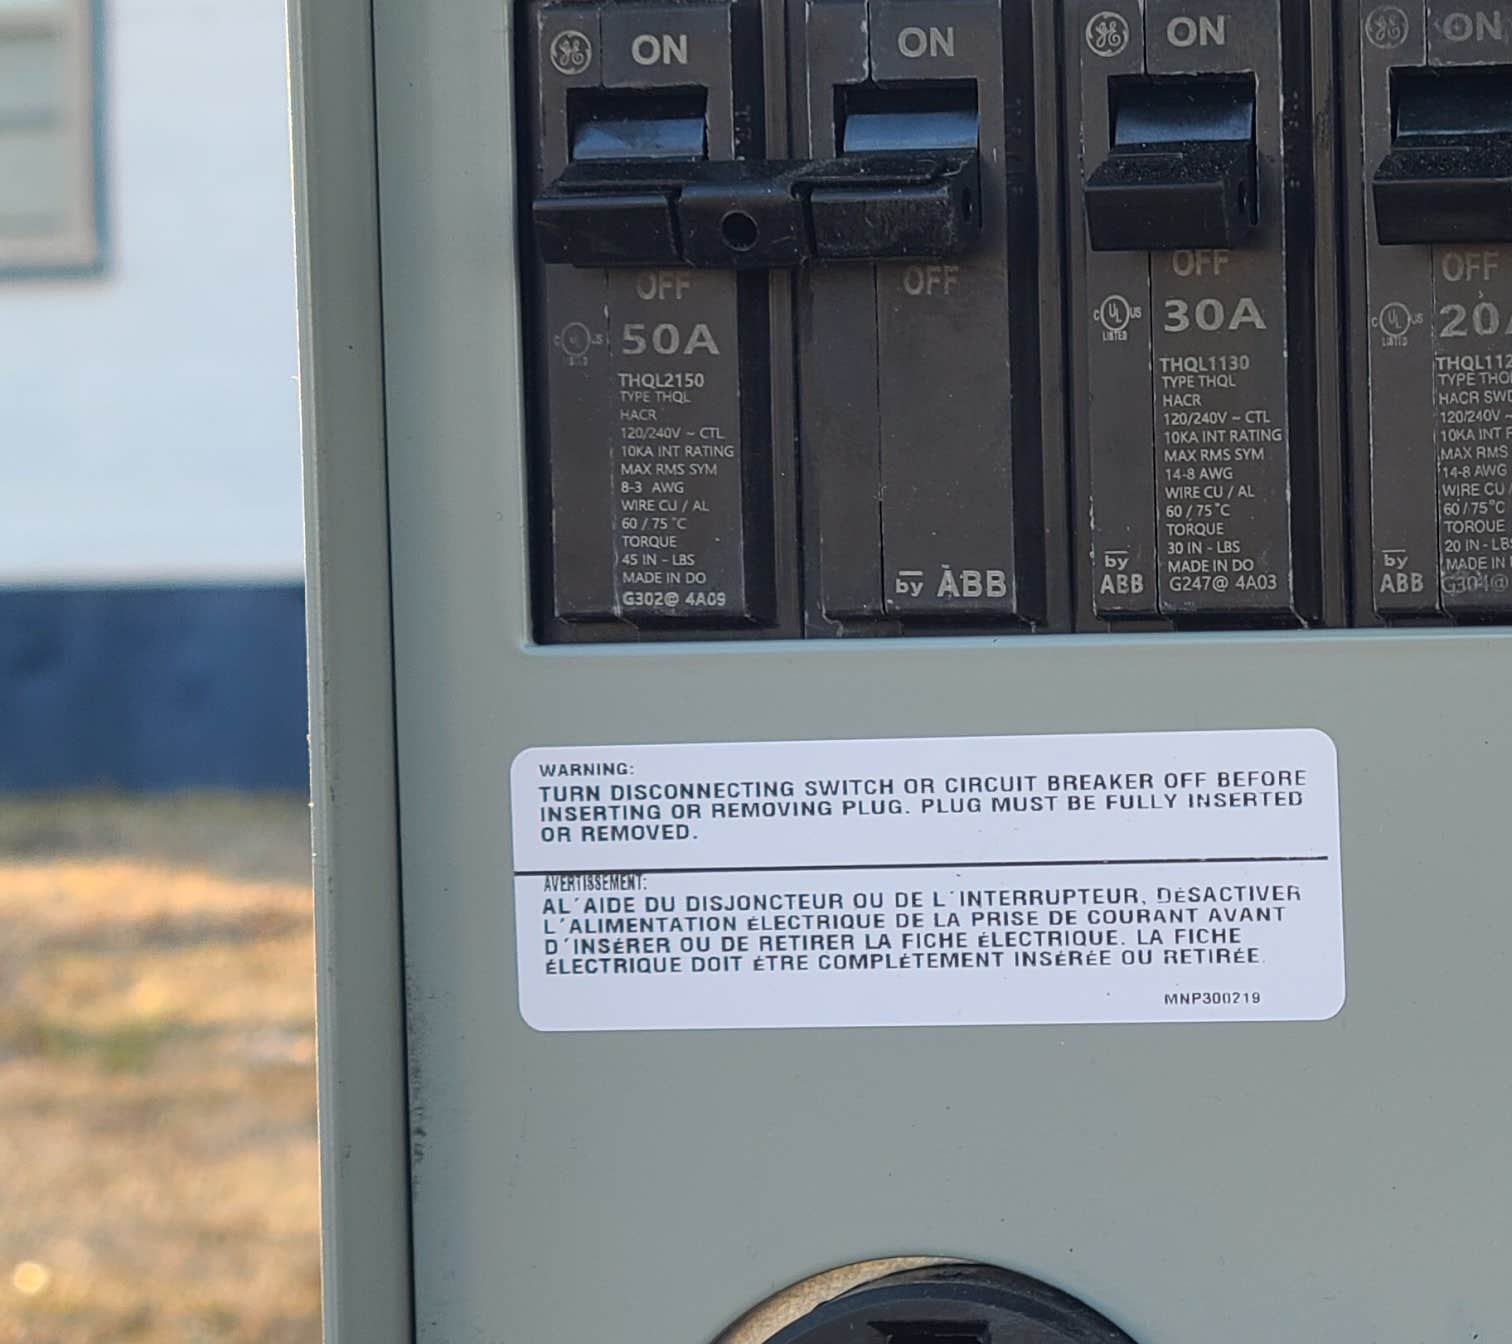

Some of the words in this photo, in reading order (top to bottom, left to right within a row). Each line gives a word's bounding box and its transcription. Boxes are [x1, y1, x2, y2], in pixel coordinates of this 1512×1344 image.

[1166, 16, 1228, 48] ON
[1443, 11, 1502, 42] ON
[632, 34, 689, 66] ON
[898, 26, 955, 58] ON
[1171, 248, 1230, 277] OFF
[1442, 252, 1499, 282] OFF
[636, 271, 691, 300] OFF
[903, 264, 960, 296] OFF
[1163, 297, 1267, 333] 30A
[622, 323, 721, 356] 50A
[1159, 354, 1251, 373] THQL1130
[618, 372, 705, 389] THQL2150
[1161, 375, 1195, 389] TYPE
[1197, 374, 1237, 388] THQL
[619, 390, 651, 402] TYPE
[654, 390, 692, 404] THQL
[1162, 394, 1202, 407] HACR
[1438, 391, 1481, 406] HACR
[1164, 449, 1197, 463] MAX
[1200, 448, 1232, 461] RMS
[1234, 447, 1265, 461] SYM
[1167, 560, 1210, 573] MADE
[1212, 559, 1228, 573] IN
[1232, 558, 1254, 571] DO
[622, 571, 663, 584] MADE
[666, 572, 681, 583] IN
[685, 572, 707, 584] DO
[895, 576, 924, 597] by
[936, 568, 1008, 599] ABB
[1099, 574, 1145, 595] ABB
[1169, 575, 1229, 592] G247@
[1234, 574, 1277, 590] 4A03
[1379, 572, 1425, 594] ABB
[538, 762, 634, 777] WARNING:
[538, 785, 601, 802] TURN
[610, 781, 794, 801] DISCONNECTING
[804, 779, 894, 797] SWITCH
[903, 777, 935, 794] OR
[945, 775, 1037, 793] CIRCUIT
[1047, 773, 1154, 791] BREAKER
[1164, 772, 1206, 788] OFF
[1217, 770, 1306, 787] BEFORE
[540, 804, 661, 823] INSERTING
[671, 804, 702, 819] OR
[711, 800, 833, 818] REMOVING
[842, 799, 910, 816] PLUG.
[921, 797, 981, 813] PLUG
[991, 796, 1058, 812] MUST
[1067, 795, 1096, 811] BE
[1106, 794, 1177, 810] FULLY
[1188, 791, 1303, 808] INSERTED
[540, 827, 572, 843] OR
[581, 824, 698, 842] REMOVED.
[543, 874, 648, 893] AVERTISSEMENT:
[1164, 992, 1261, 1005] MNP300219
